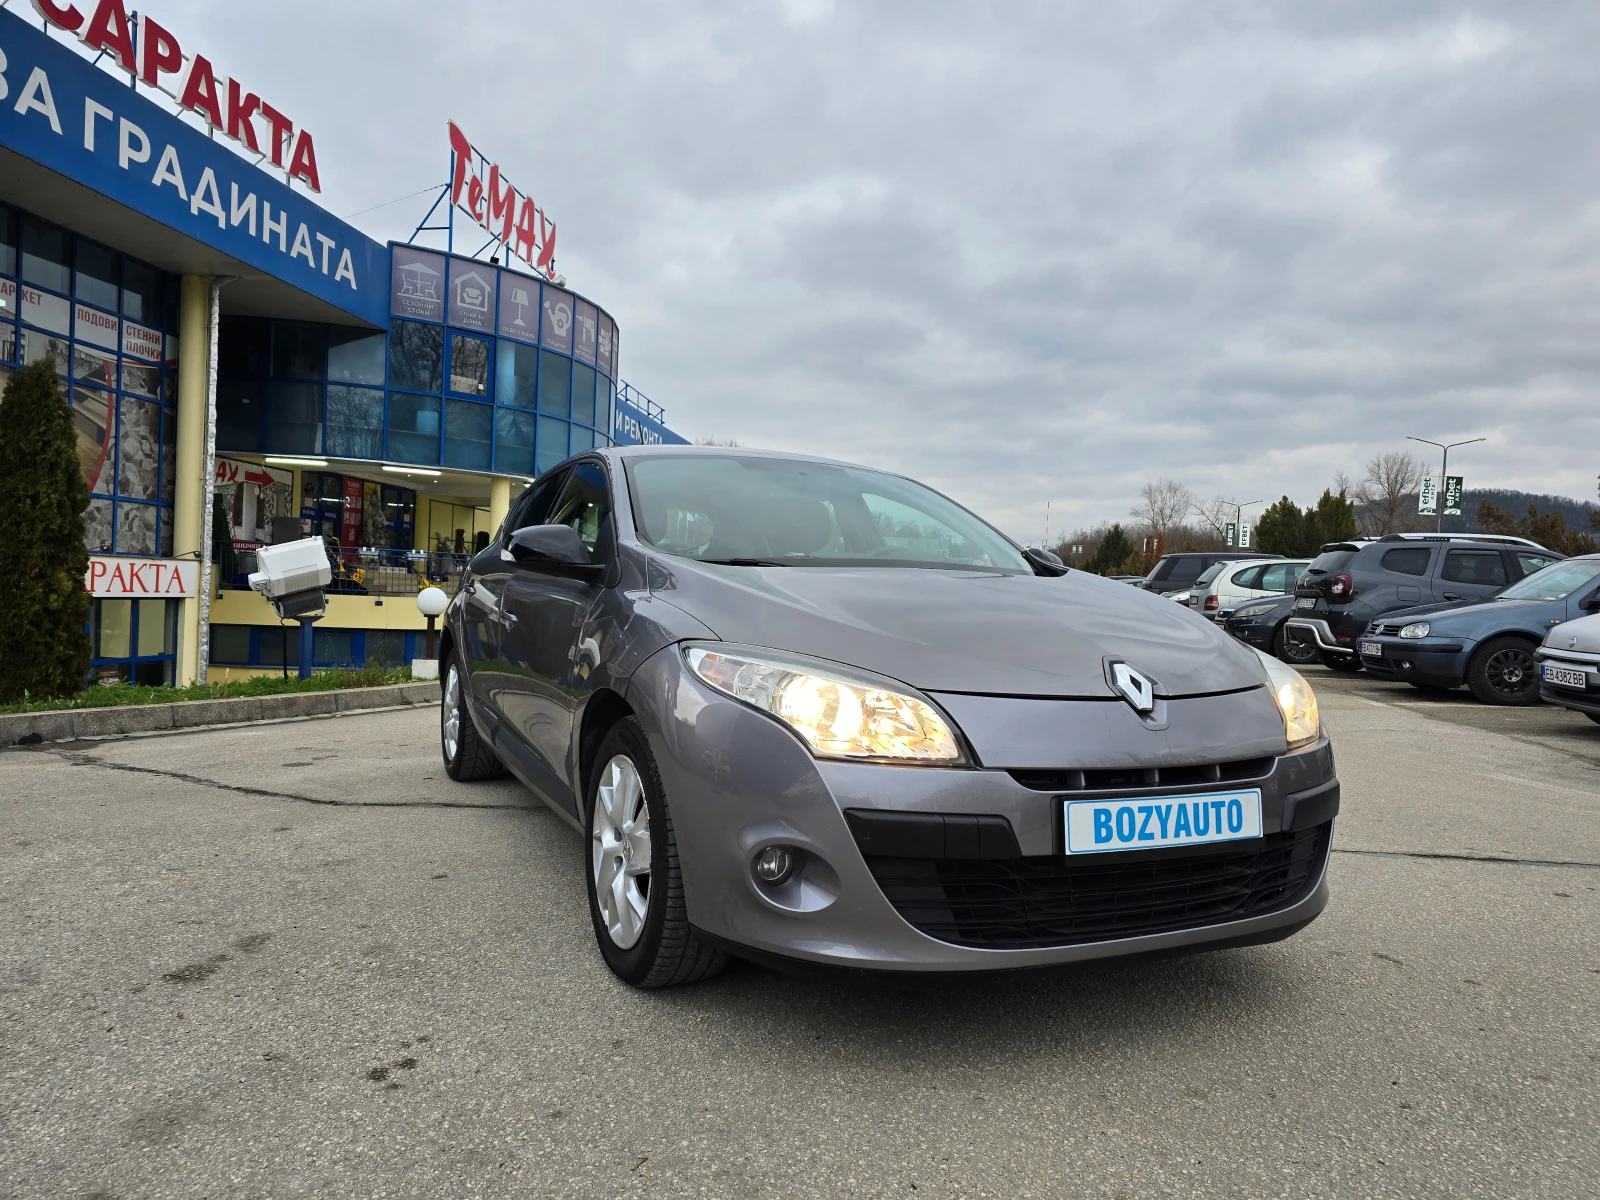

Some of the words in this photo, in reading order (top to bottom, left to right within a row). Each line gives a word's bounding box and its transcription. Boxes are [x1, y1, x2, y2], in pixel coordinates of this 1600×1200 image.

[0, 46, 63, 136] А
[84, 96, 357, 290] ГРАДИНАТА
[402, 299, 434, 310] СЕЗОННИ
[407, 307, 430, 316] СТОКИ
[77, 308, 117, 332] ПОДОВИ
[463, 318, 482, 326] ДОМА
[126, 325, 160, 346] СТЕННИ
[502, 325, 536, 339] ОСВЕТЛЕНИЕ
[126, 340, 162, 360] ПЛОЧКИ
[616, 409, 623, 431] И
[1446, 478, 1456, 506] efbet
[84, 561, 185, 593] РАКТА
[1555, 670, 1572, 684] 4382
[1573, 672, 1584, 686] BB
[1093, 798, 1243, 844] BOZYAUTO
